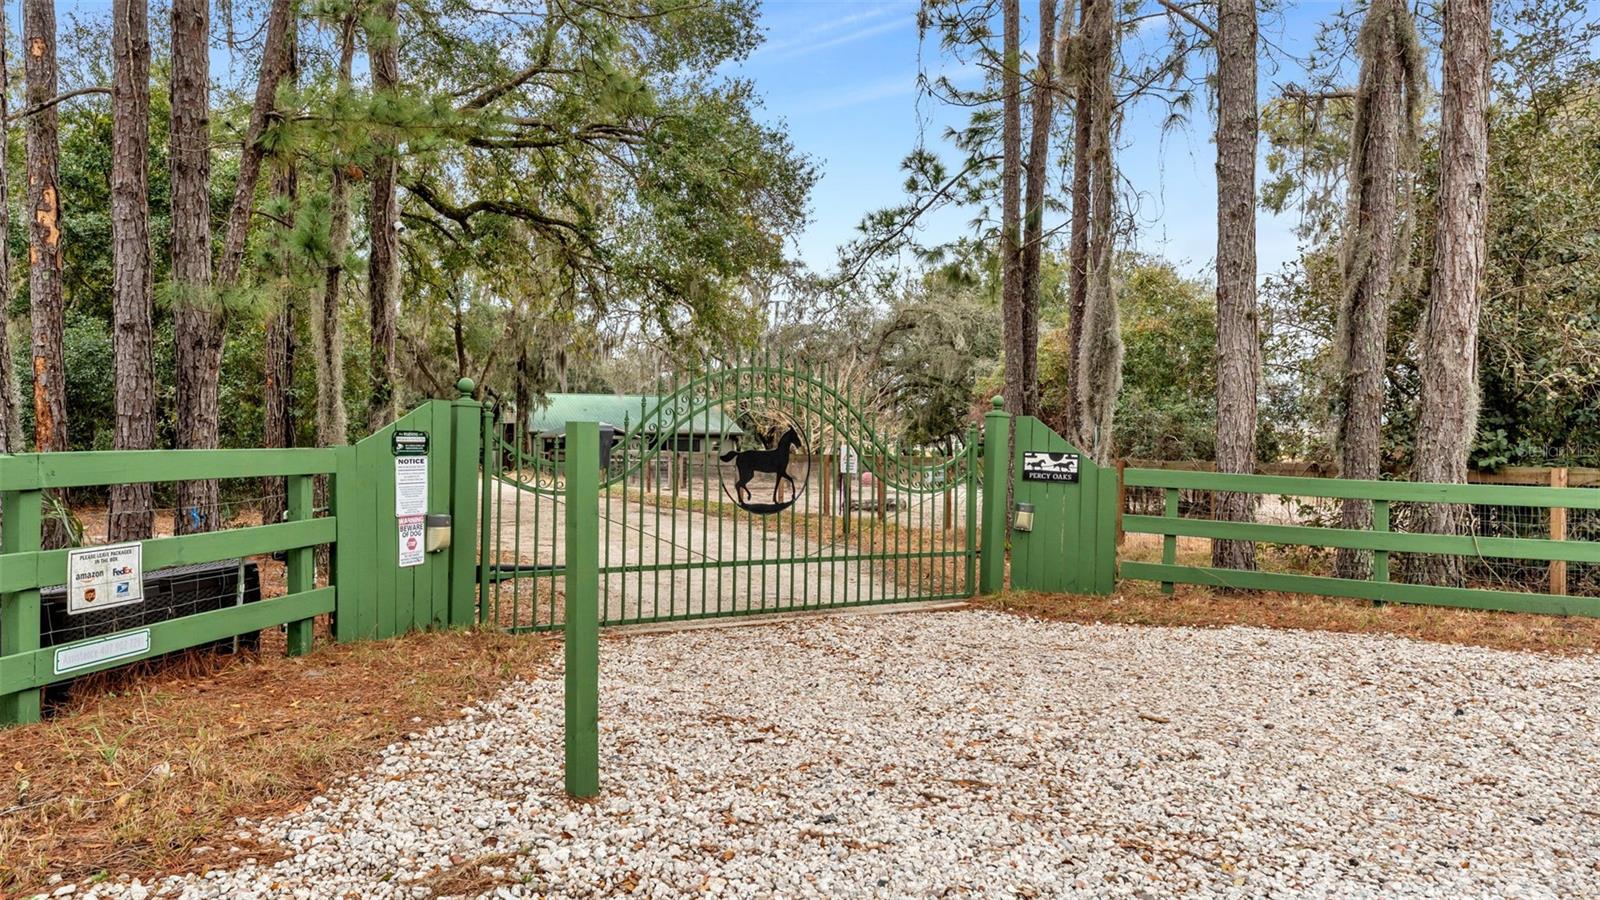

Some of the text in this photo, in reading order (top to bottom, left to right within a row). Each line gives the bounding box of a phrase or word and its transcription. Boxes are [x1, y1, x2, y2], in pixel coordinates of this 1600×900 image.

[400, 524, 423, 532] BEWARE
[80, 548, 132, 561] PLEASE LEAVE PACKAGES
[75, 570, 104, 580] amazon
[112, 566, 133, 576] FedEx
